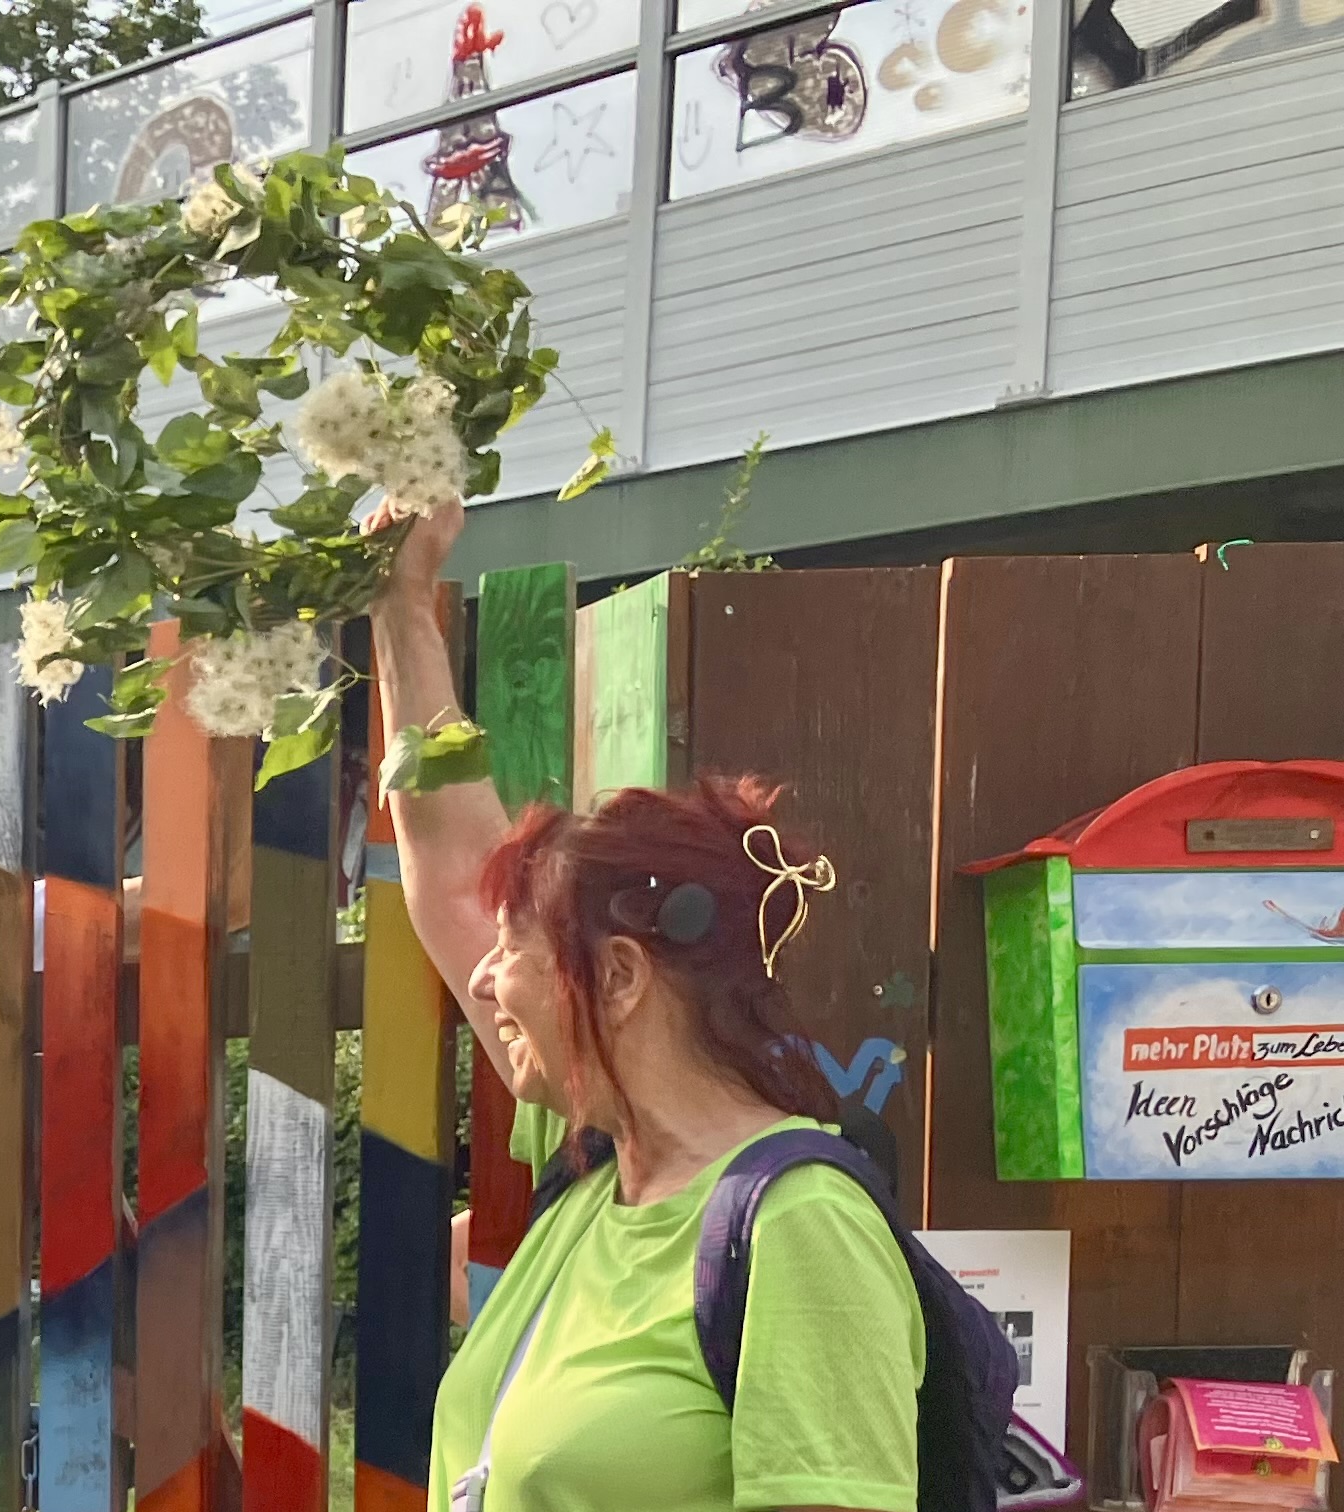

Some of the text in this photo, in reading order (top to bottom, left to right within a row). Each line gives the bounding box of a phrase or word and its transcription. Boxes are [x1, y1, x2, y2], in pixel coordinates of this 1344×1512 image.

[1130, 1036, 1189, 1062] mehr
[1192, 1032, 1251, 1062] Platz
[1252, 1041, 1297, 1061] zum
[1124, 1079, 1197, 1126] Ideen
[1163, 1072, 1294, 1166] Vorschläge
[1248, 1095, 1344, 1158] Nachric
